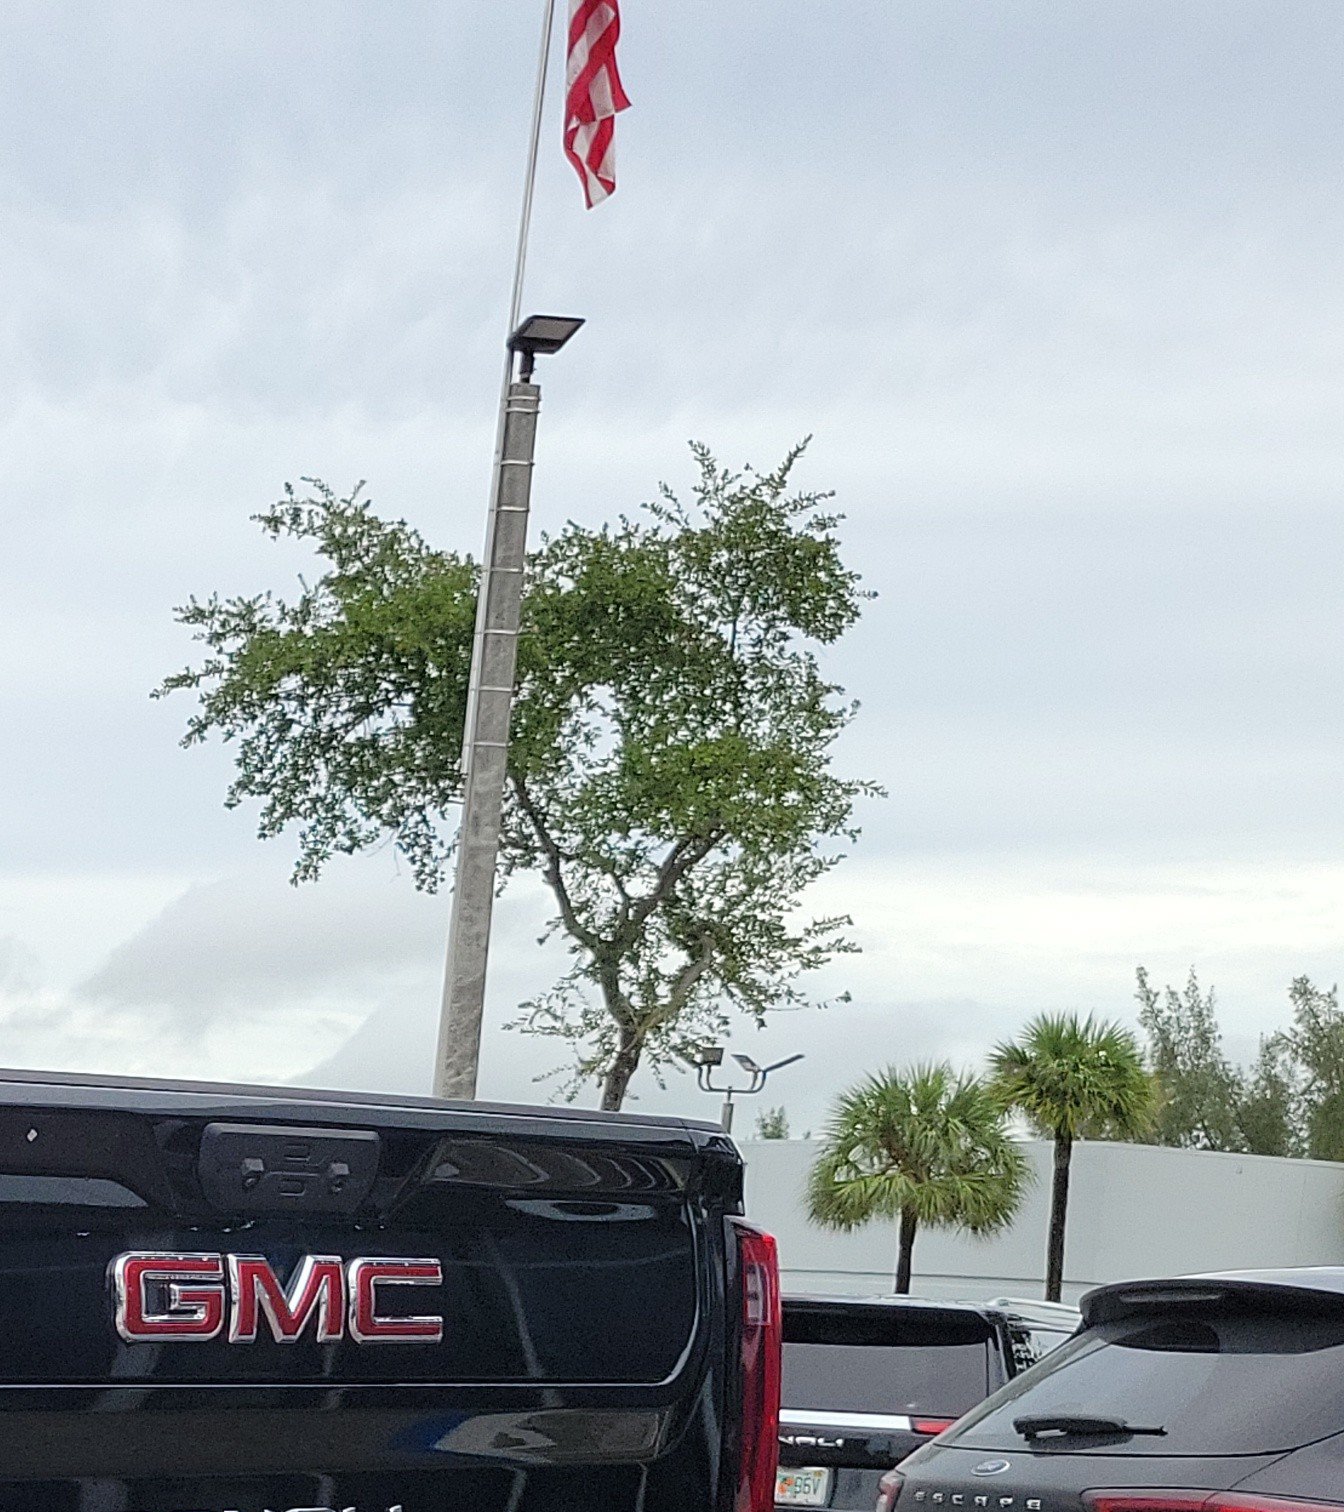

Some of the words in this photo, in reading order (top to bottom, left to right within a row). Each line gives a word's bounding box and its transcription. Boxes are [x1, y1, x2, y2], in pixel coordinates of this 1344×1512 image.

[113, 1250, 444, 1345] GMC
[777, 1435, 844, 1448] NALI
[914, 1490, 1042, 1511] ESCAPE
